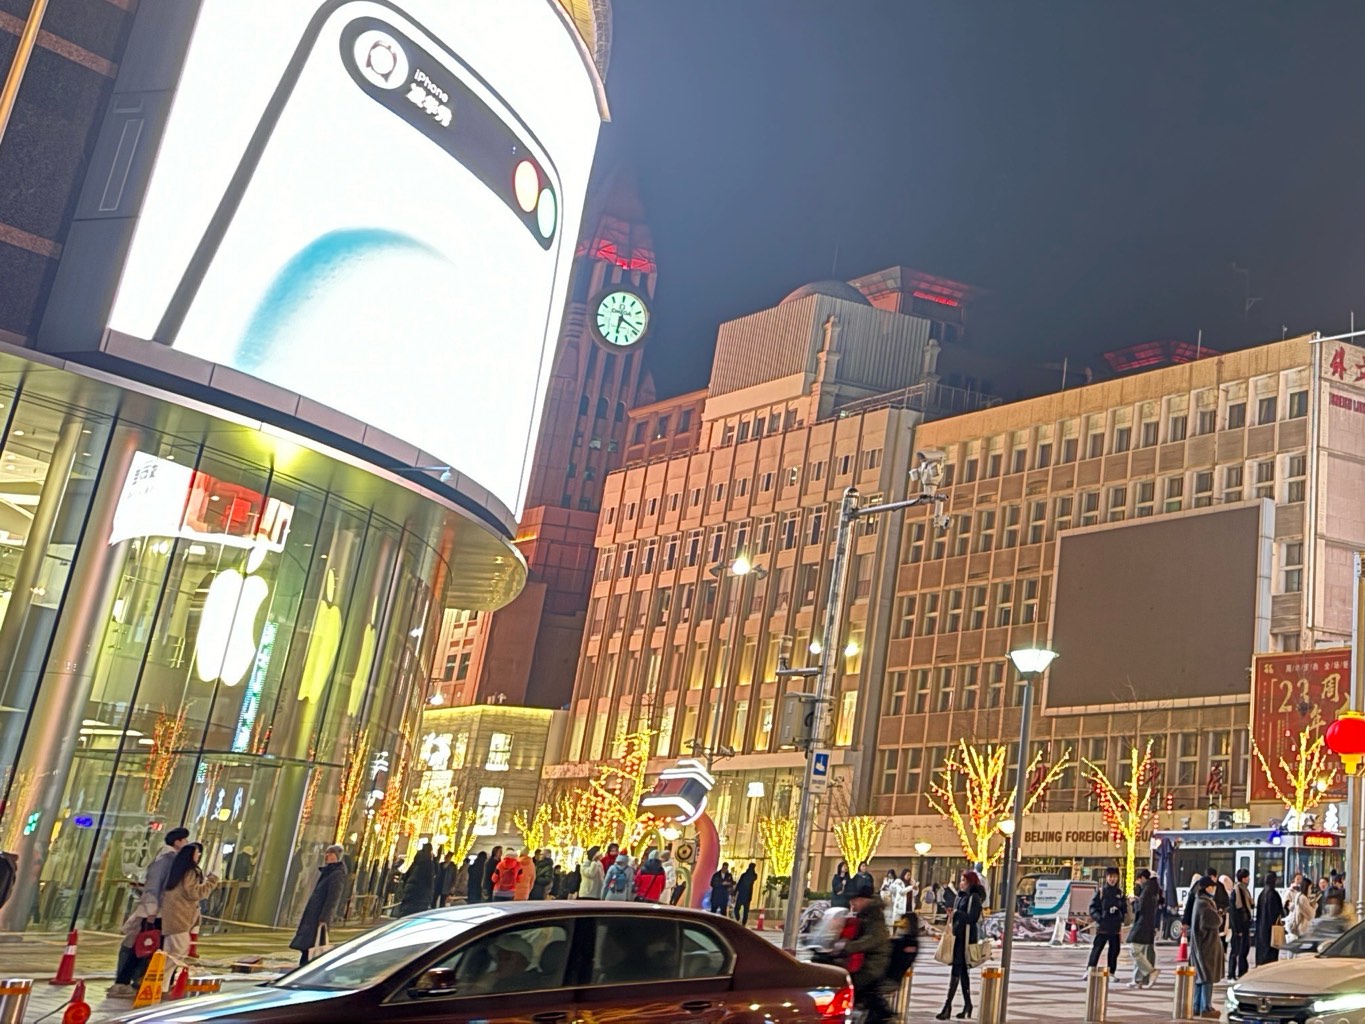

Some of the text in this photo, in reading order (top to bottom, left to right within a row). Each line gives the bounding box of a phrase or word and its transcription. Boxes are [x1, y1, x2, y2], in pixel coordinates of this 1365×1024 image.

[414, 69, 449, 103] iPhone
[1024, 831, 1062, 843] BEIJING
[1065, 831, 1109, 842] FOREIGN
